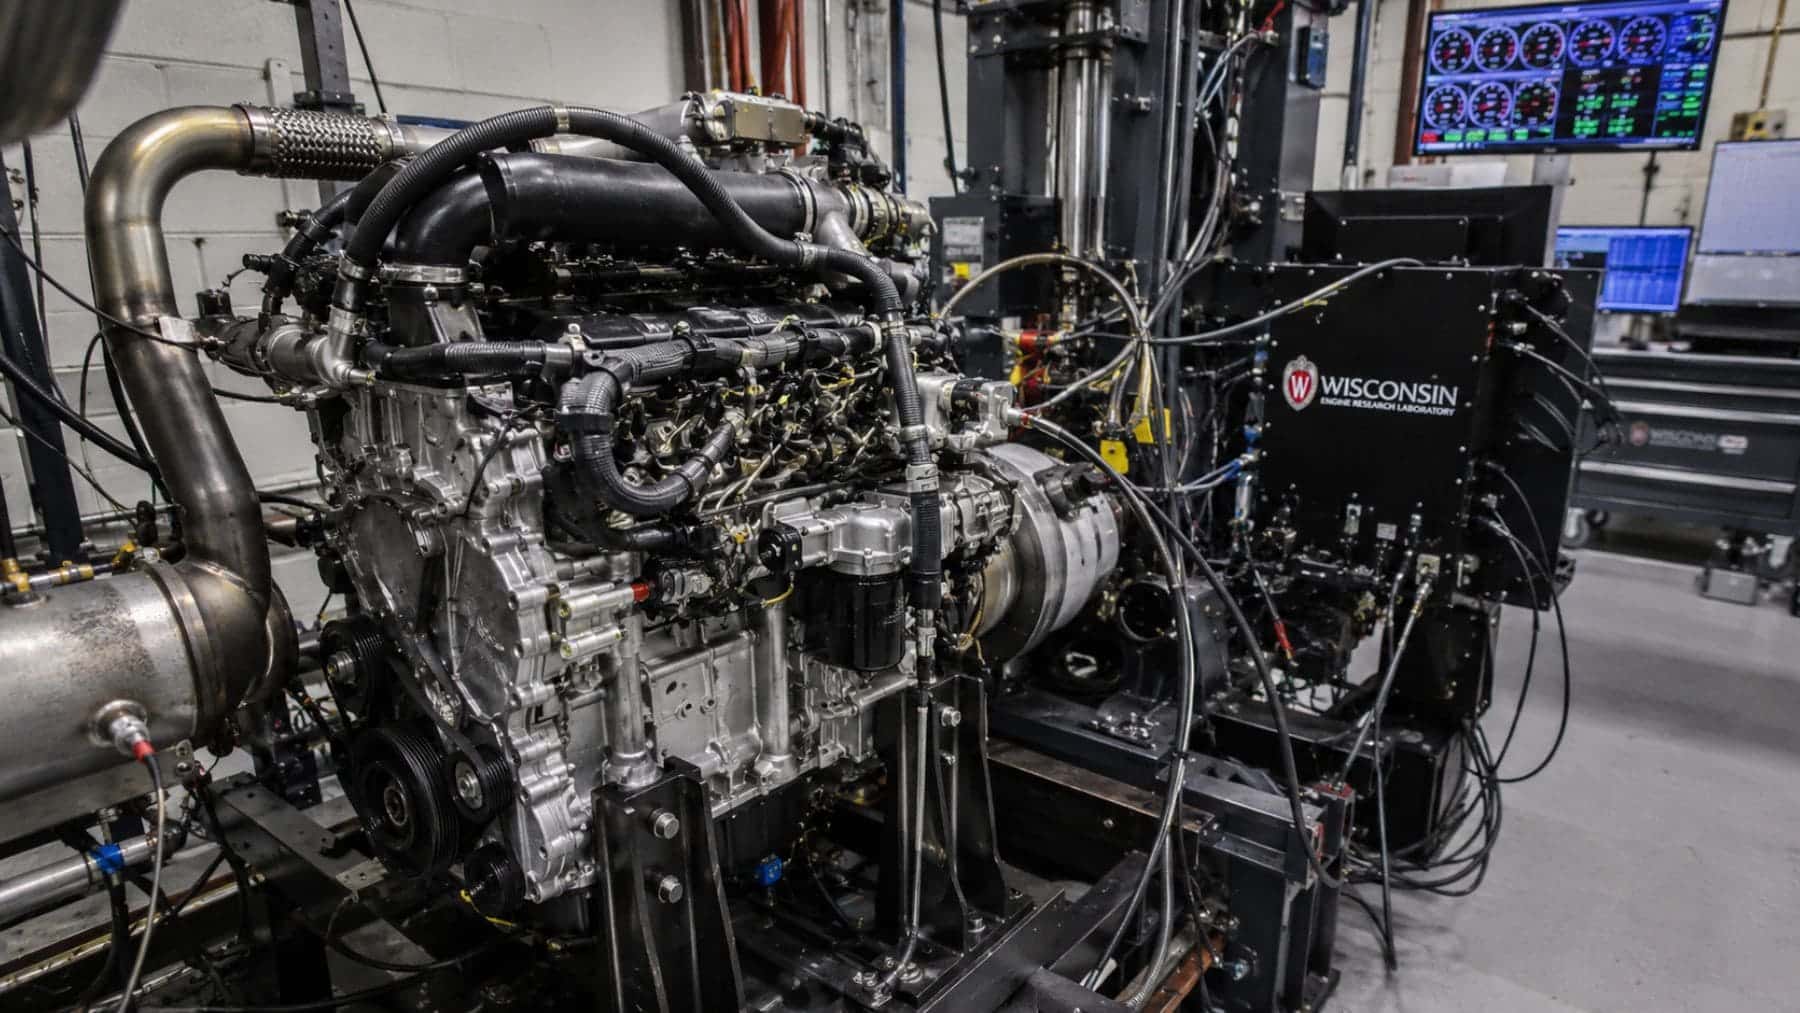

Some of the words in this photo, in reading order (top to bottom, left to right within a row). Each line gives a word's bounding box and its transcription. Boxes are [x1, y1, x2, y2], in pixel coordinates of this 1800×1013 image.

[1291, 374, 1310, 400] W
[1320, 375, 1458, 406] WISCONSIN
[1320, 396, 1351, 407] ENGINE
[1352, 398, 1395, 411] RESEARCH
[1397, 403, 1456, 416] LABORATORY
